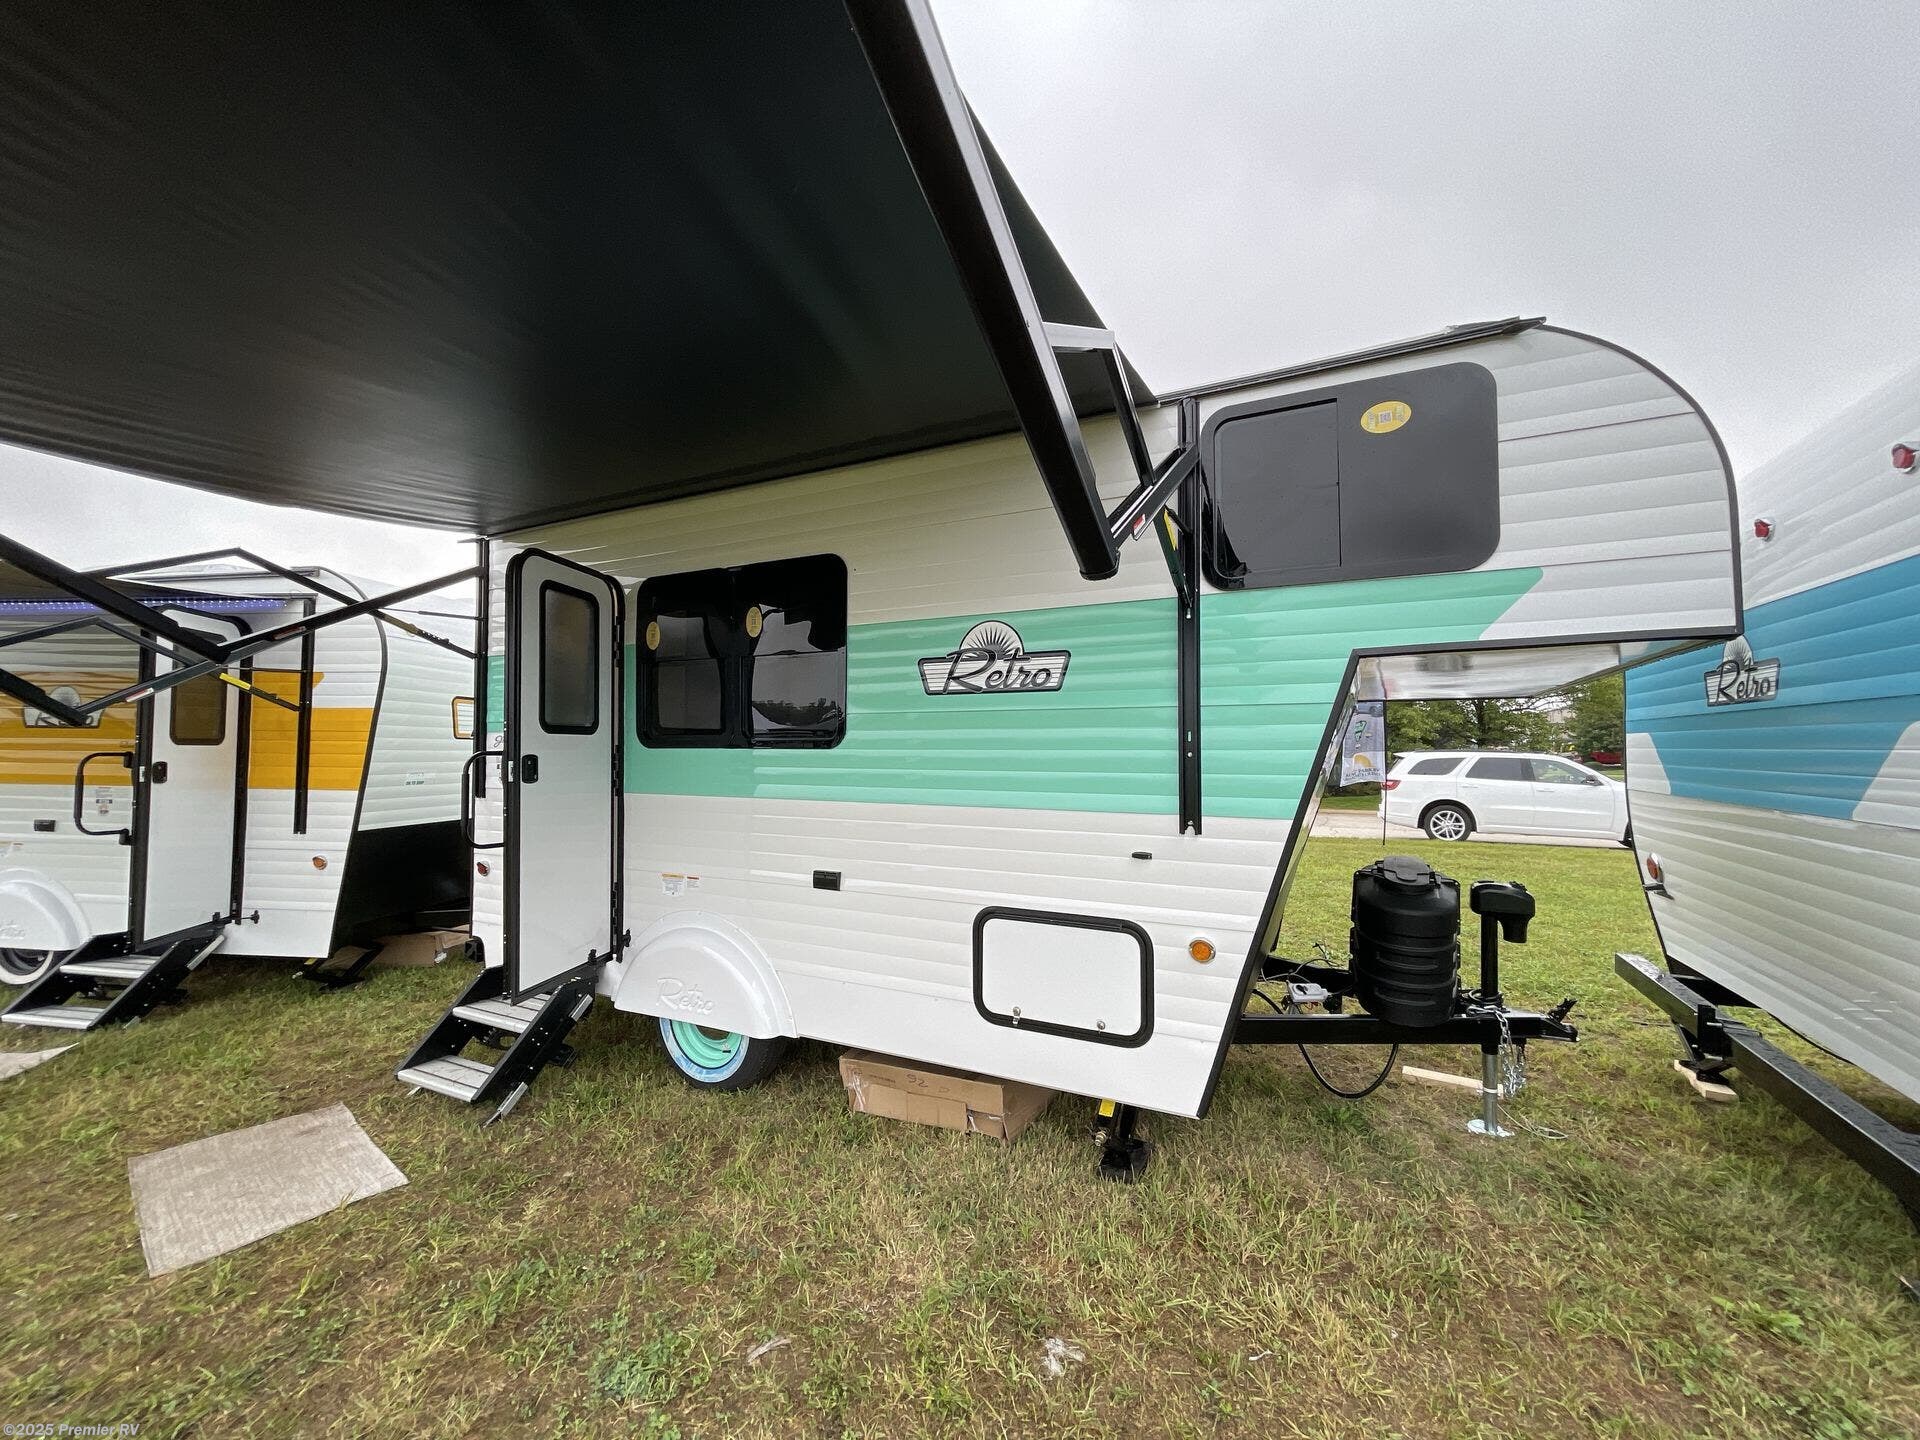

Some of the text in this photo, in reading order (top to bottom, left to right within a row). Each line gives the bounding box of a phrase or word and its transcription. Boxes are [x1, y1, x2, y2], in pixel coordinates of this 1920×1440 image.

[942, 646, 1052, 695] Retro
[1715, 656, 1771, 704] Retro
[655, 977, 715, 1016] Retro
